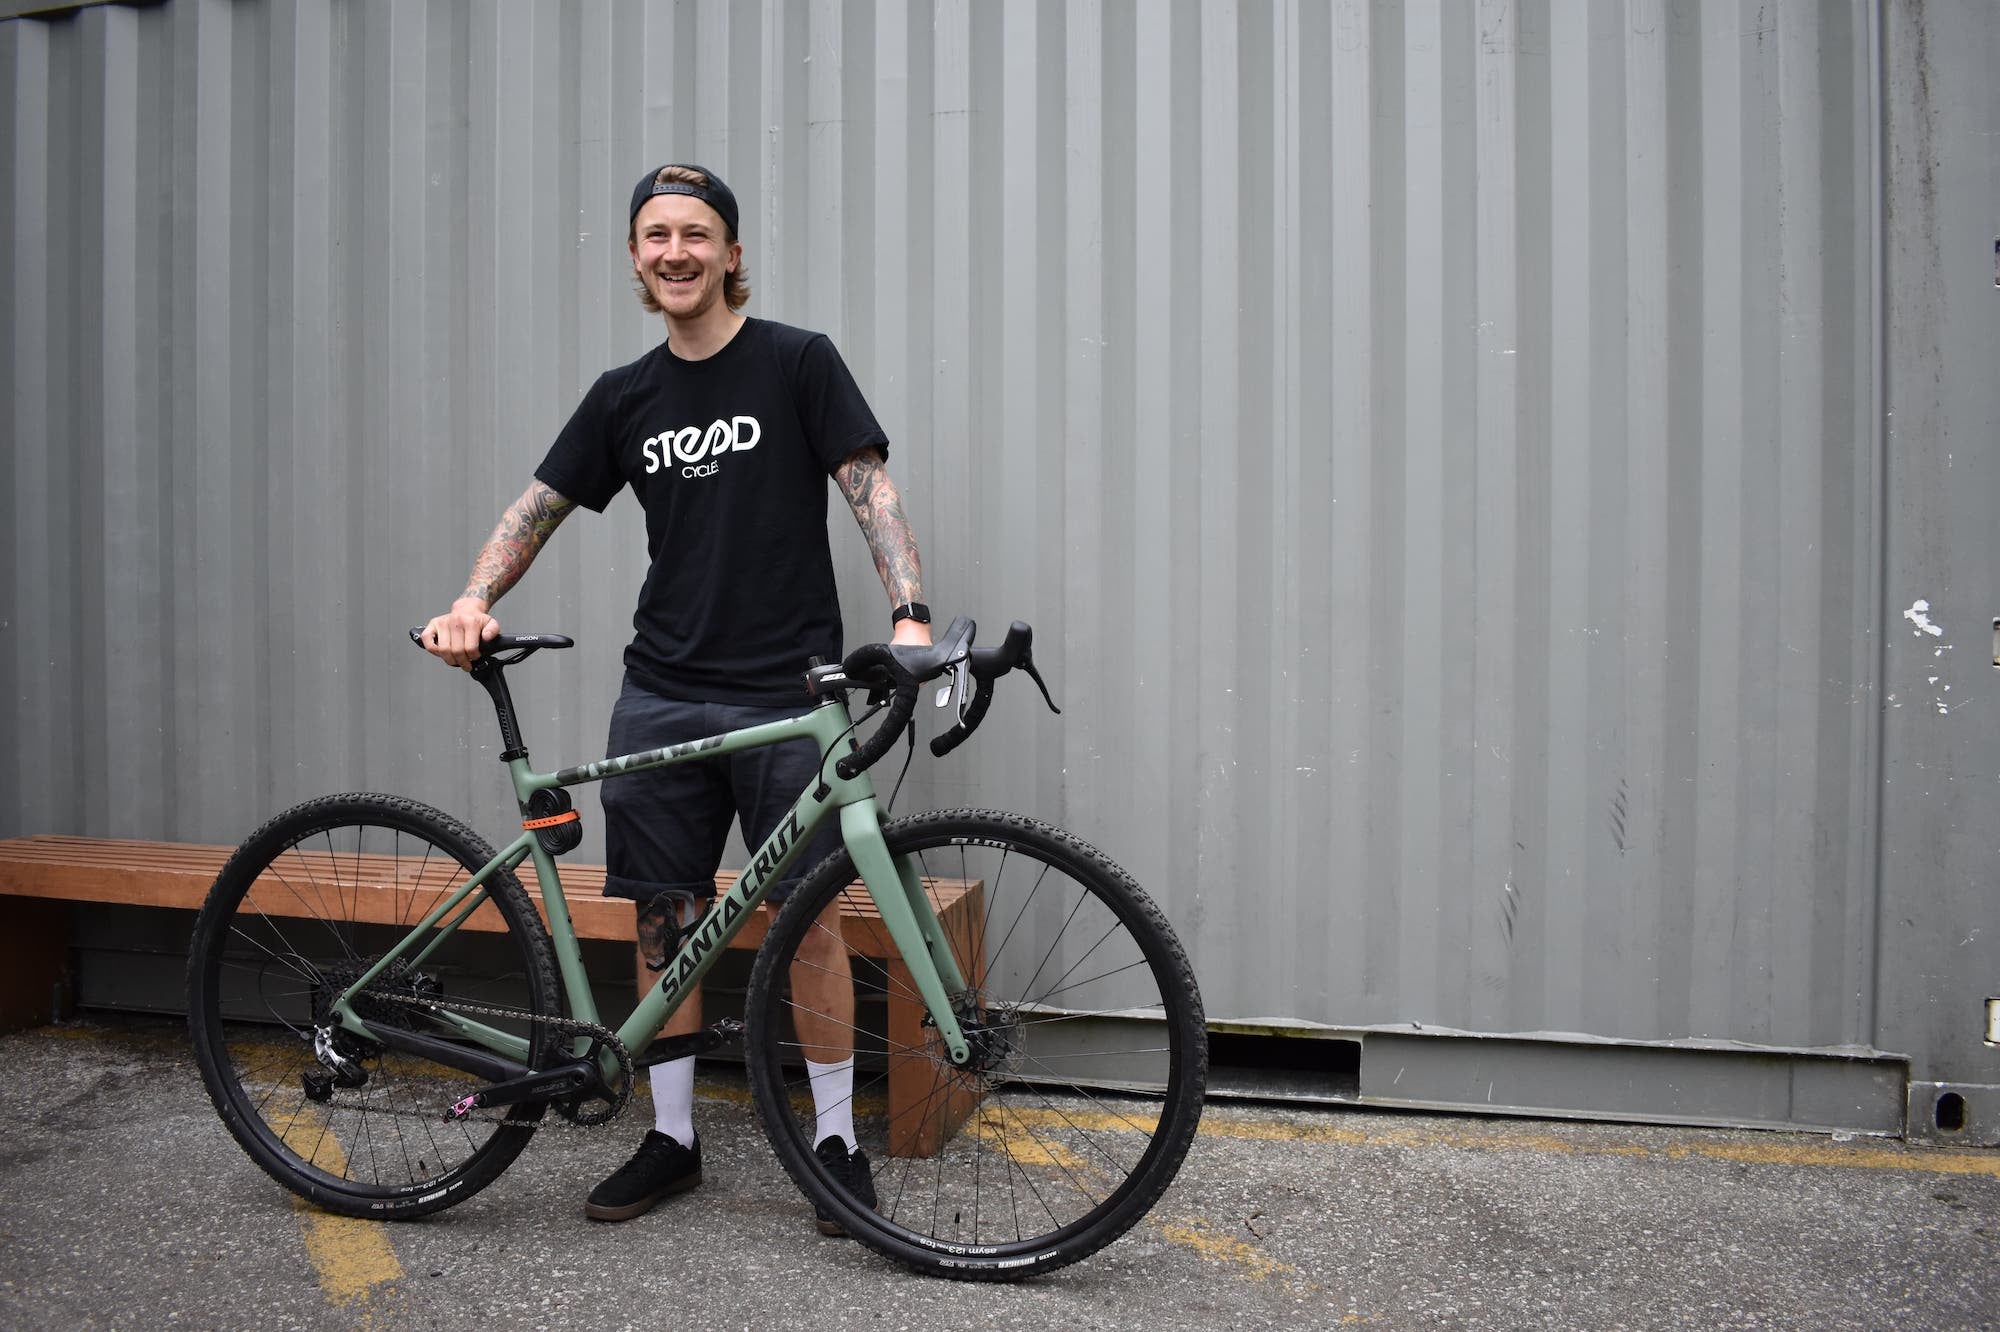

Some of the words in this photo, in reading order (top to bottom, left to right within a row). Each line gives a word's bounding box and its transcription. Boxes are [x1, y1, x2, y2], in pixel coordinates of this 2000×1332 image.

[661, 895, 743, 1003] SANTA
[740, 811, 806, 901] CRUZ
[968, 1246, 998, 1255] asym
